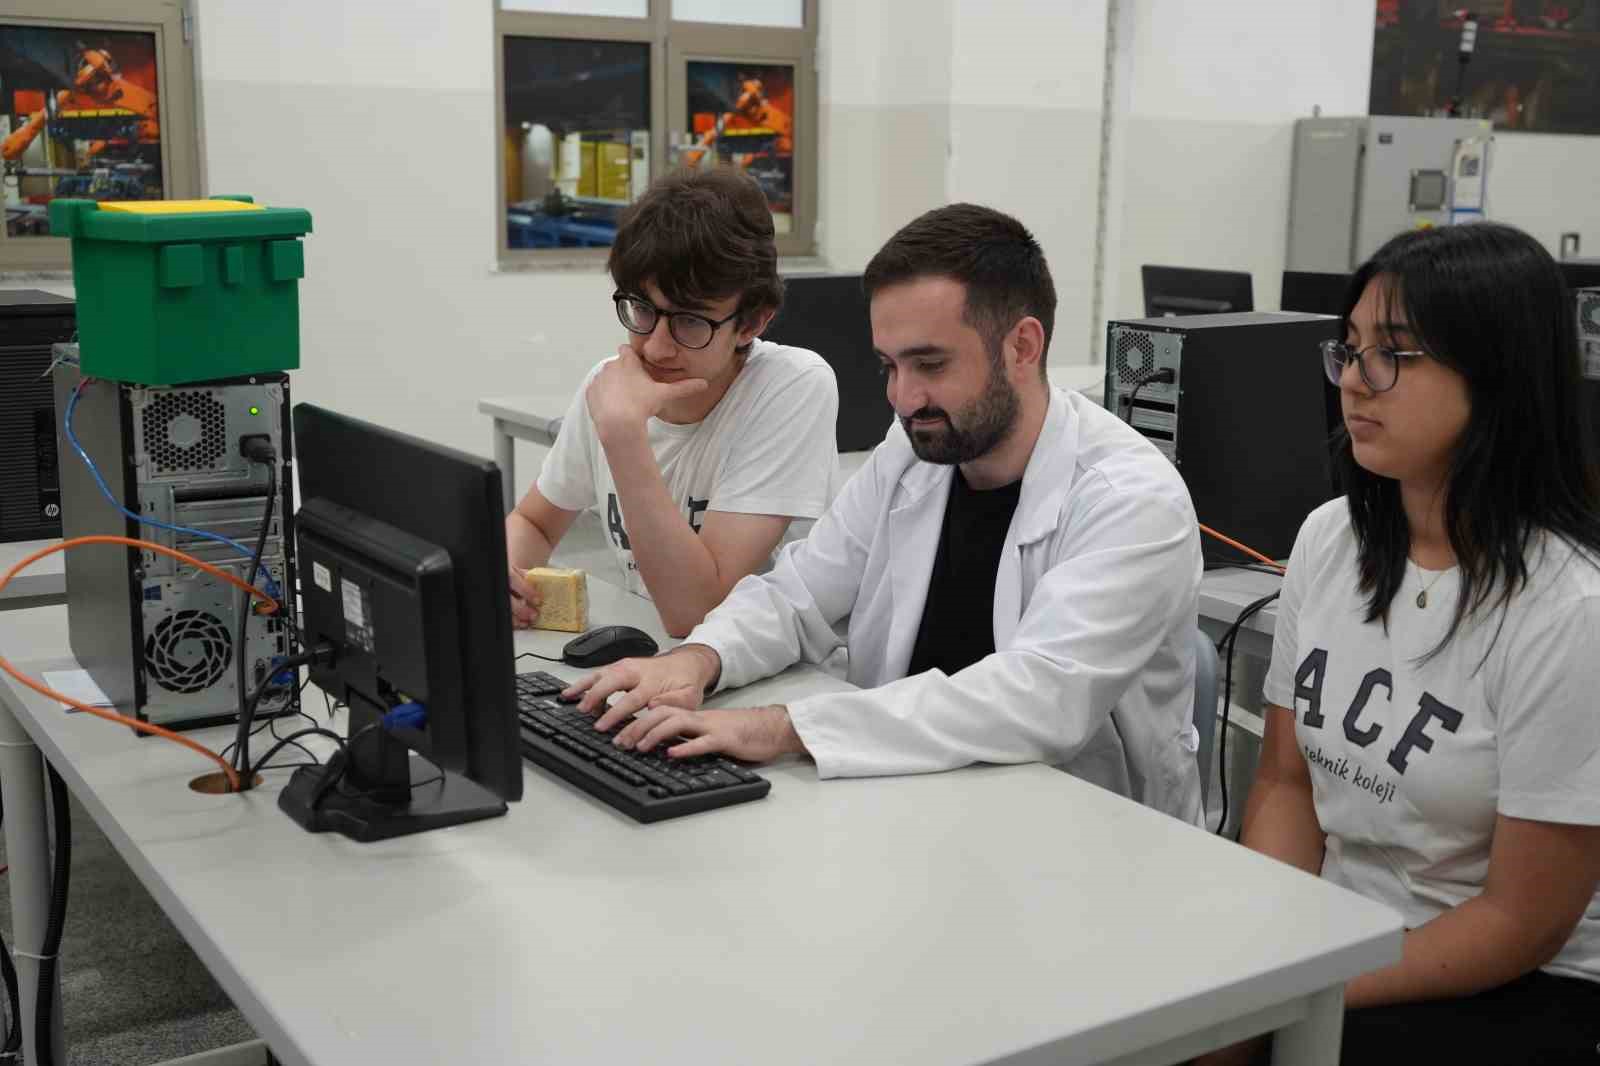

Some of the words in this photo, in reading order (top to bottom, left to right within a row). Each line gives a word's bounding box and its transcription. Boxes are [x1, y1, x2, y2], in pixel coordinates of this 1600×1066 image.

[607, 492, 709, 551] AF
[1294, 647, 1464, 776] ACF
[1353, 765, 1396, 804] koleji
